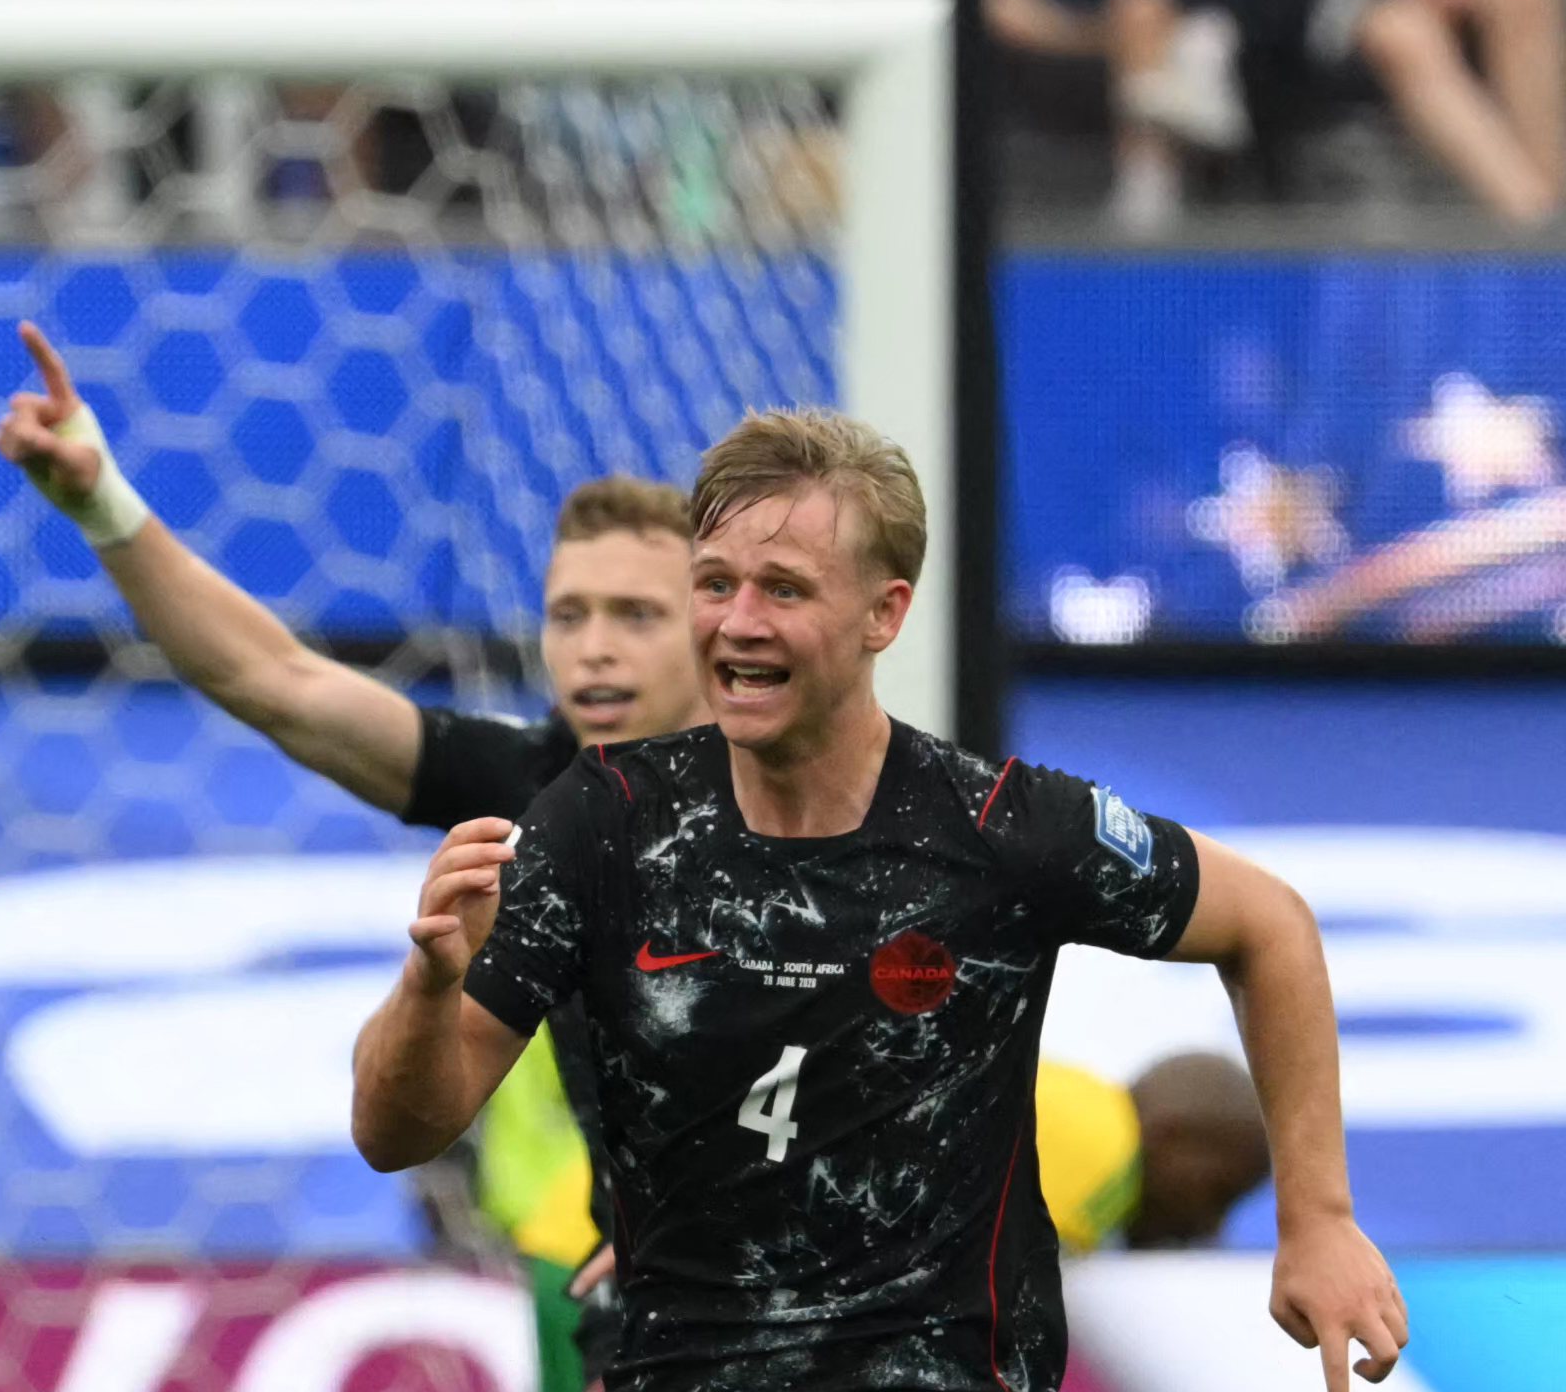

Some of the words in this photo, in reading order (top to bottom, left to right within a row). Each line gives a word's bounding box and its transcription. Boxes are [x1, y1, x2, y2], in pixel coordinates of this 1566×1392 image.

[783, 962, 813, 974] SOUTH
[815, 963, 845, 975] AFRICA
[874, 966, 951, 980] CANADA
[738, 1045, 808, 1163] 4
